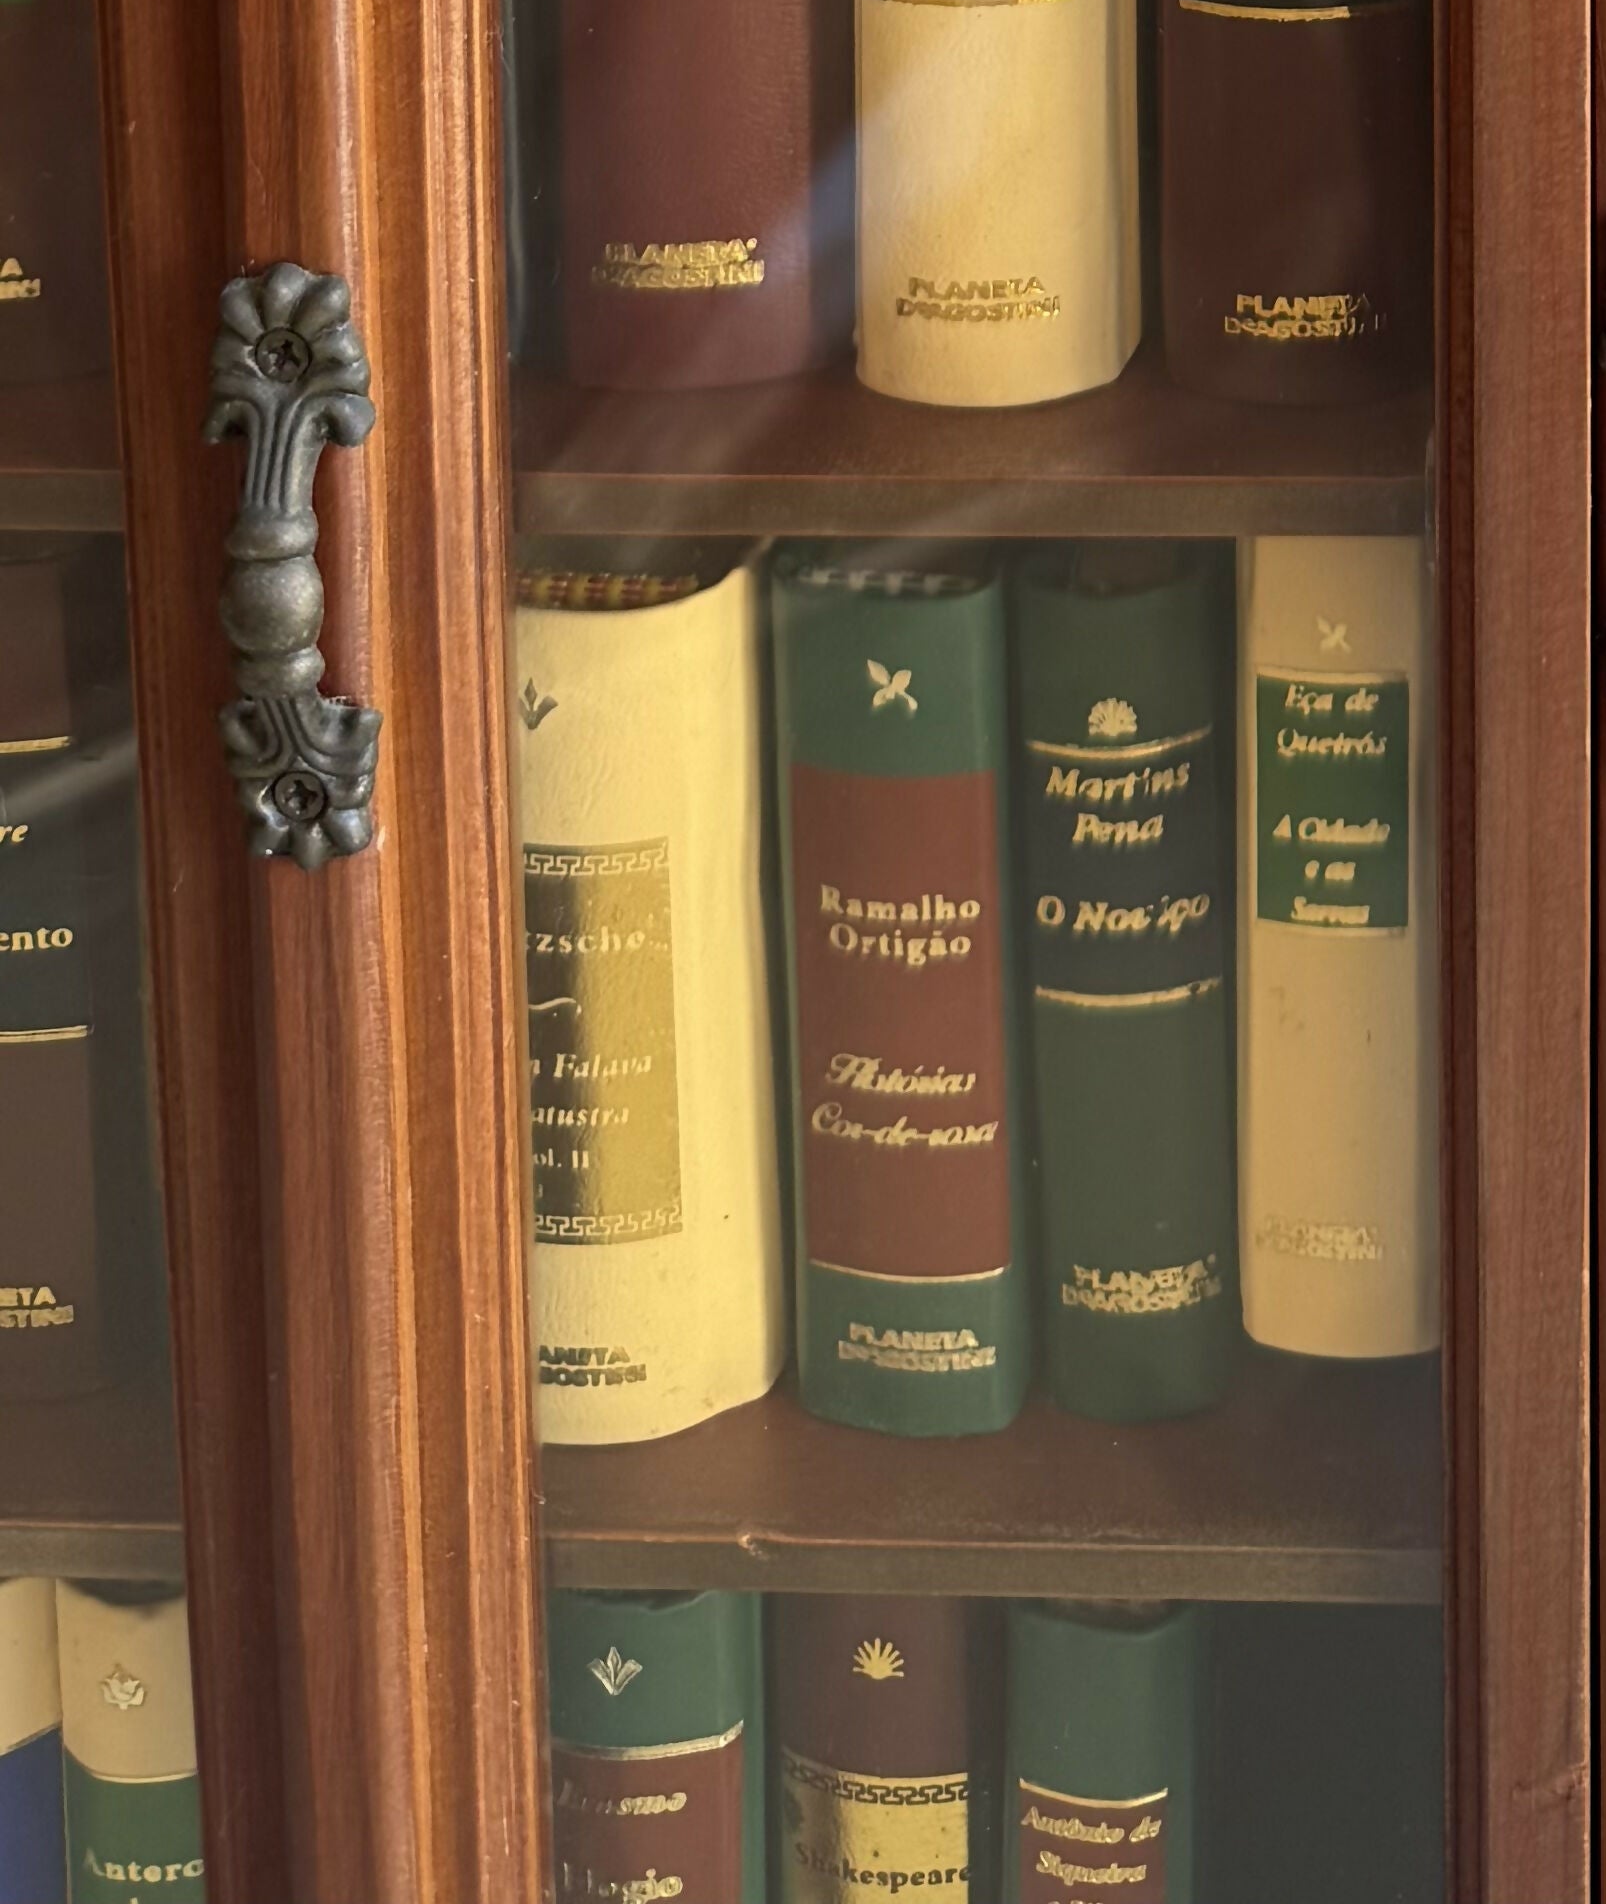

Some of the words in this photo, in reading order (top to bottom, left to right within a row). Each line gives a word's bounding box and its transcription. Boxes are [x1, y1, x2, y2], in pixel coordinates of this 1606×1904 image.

[908, 275, 1047, 301] PLANETA
[1344, 686, 1380, 713] de
[1045, 761, 1191, 799] Martins
[1072, 811, 1165, 845] Pena
[1272, 813, 1293, 839] A
[820, 883, 982, 922] Ramalho
[1036, 894, 1067, 926] O
[829, 922, 972, 966] Ortigão
[531, 1104, 630, 1128] atustra
